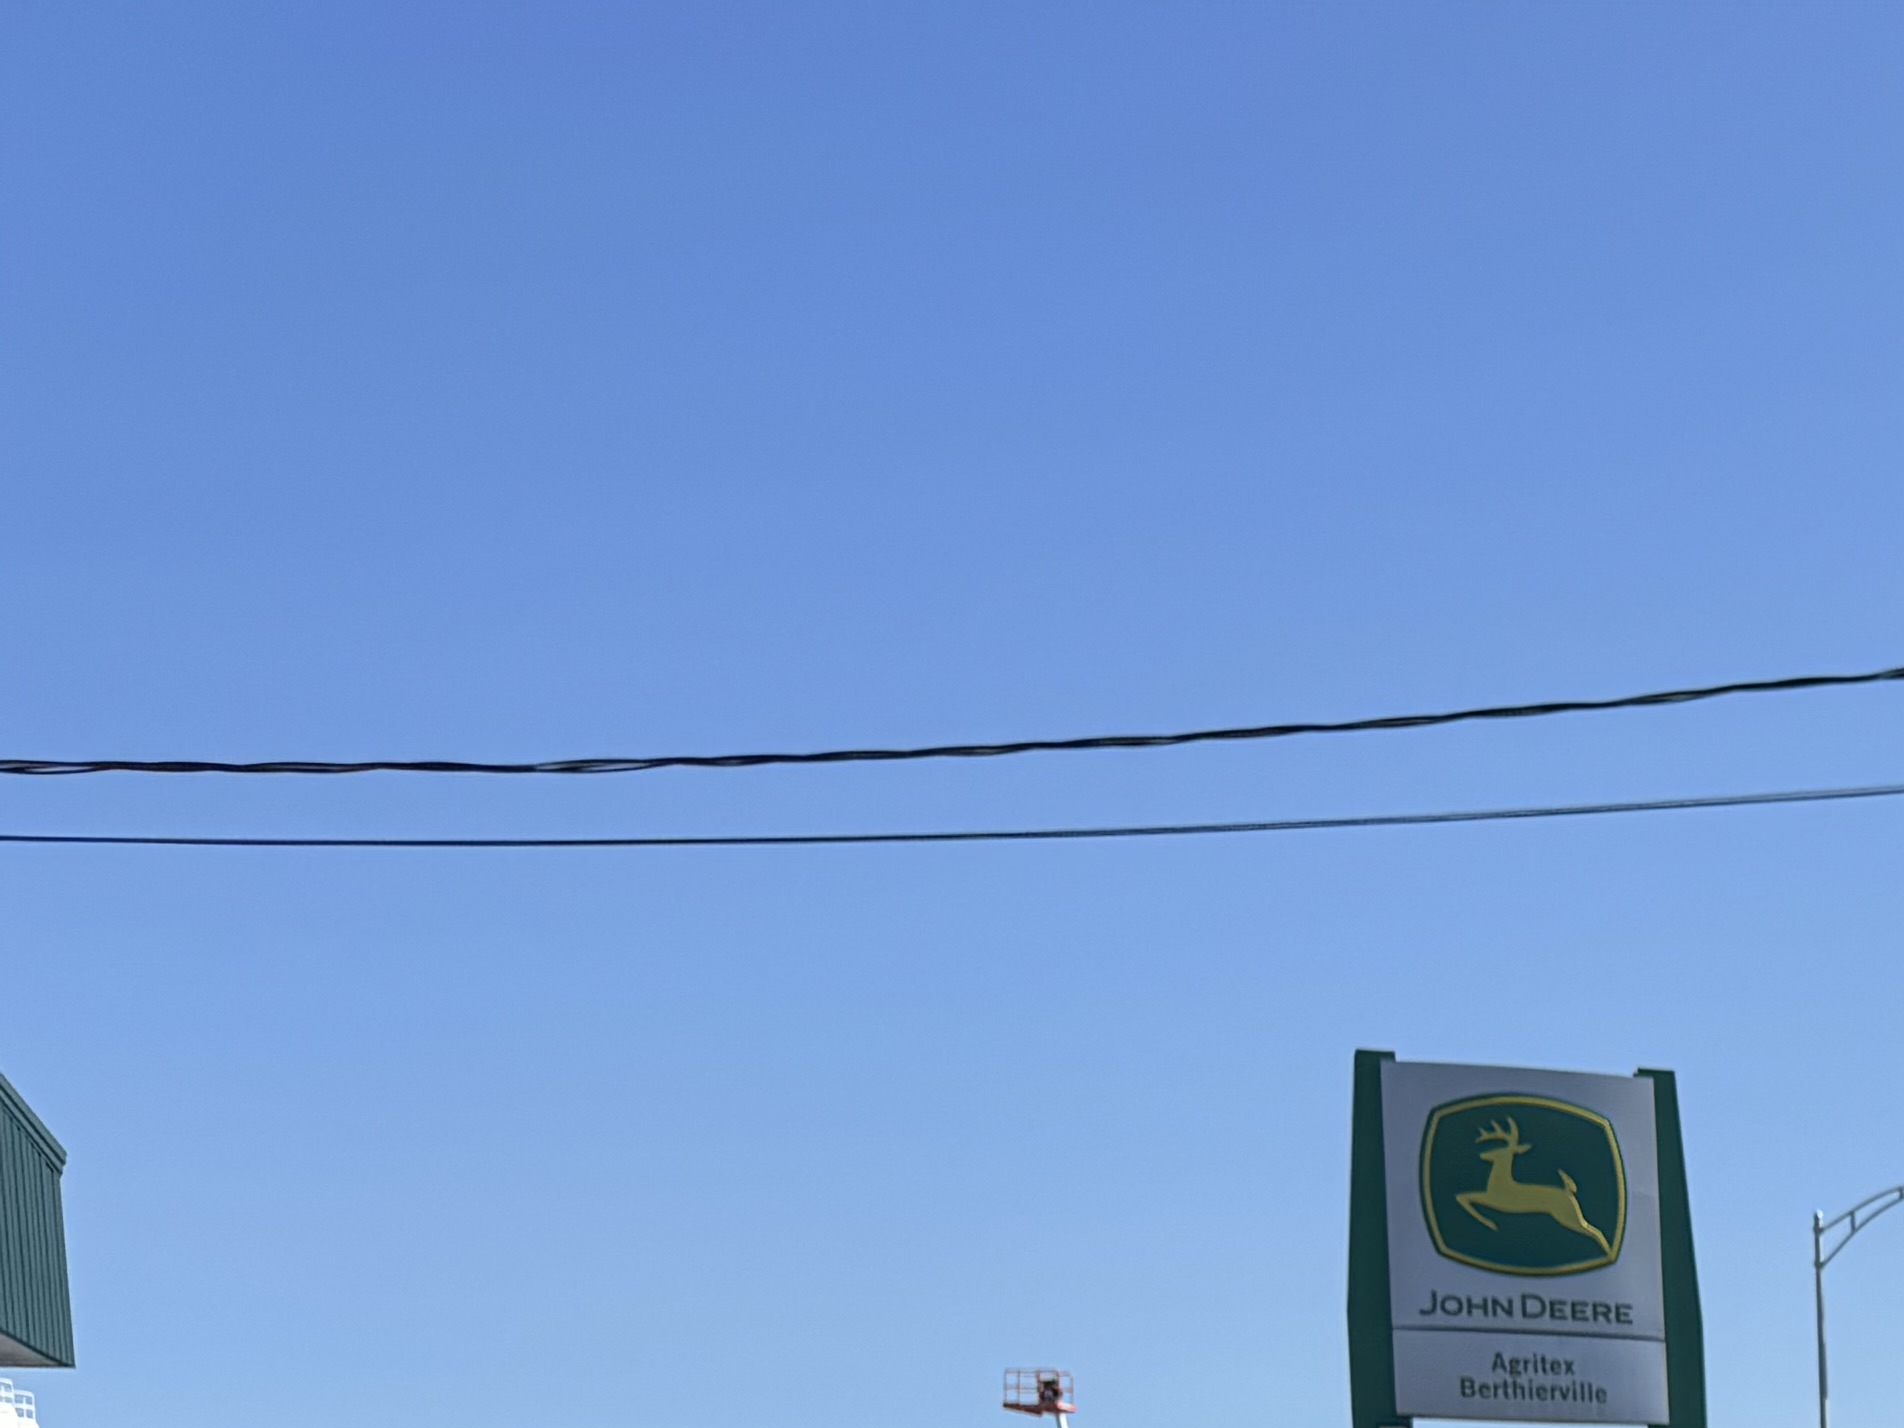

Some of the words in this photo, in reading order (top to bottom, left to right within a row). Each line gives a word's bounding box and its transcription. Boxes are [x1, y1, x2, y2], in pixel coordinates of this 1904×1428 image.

[1418, 1289, 1513, 1319] JOHN
[1520, 1292, 1633, 1325] DEERE
[1492, 1351, 1575, 1379] Agritex
[1459, 1376, 1608, 1405] Berthierville
